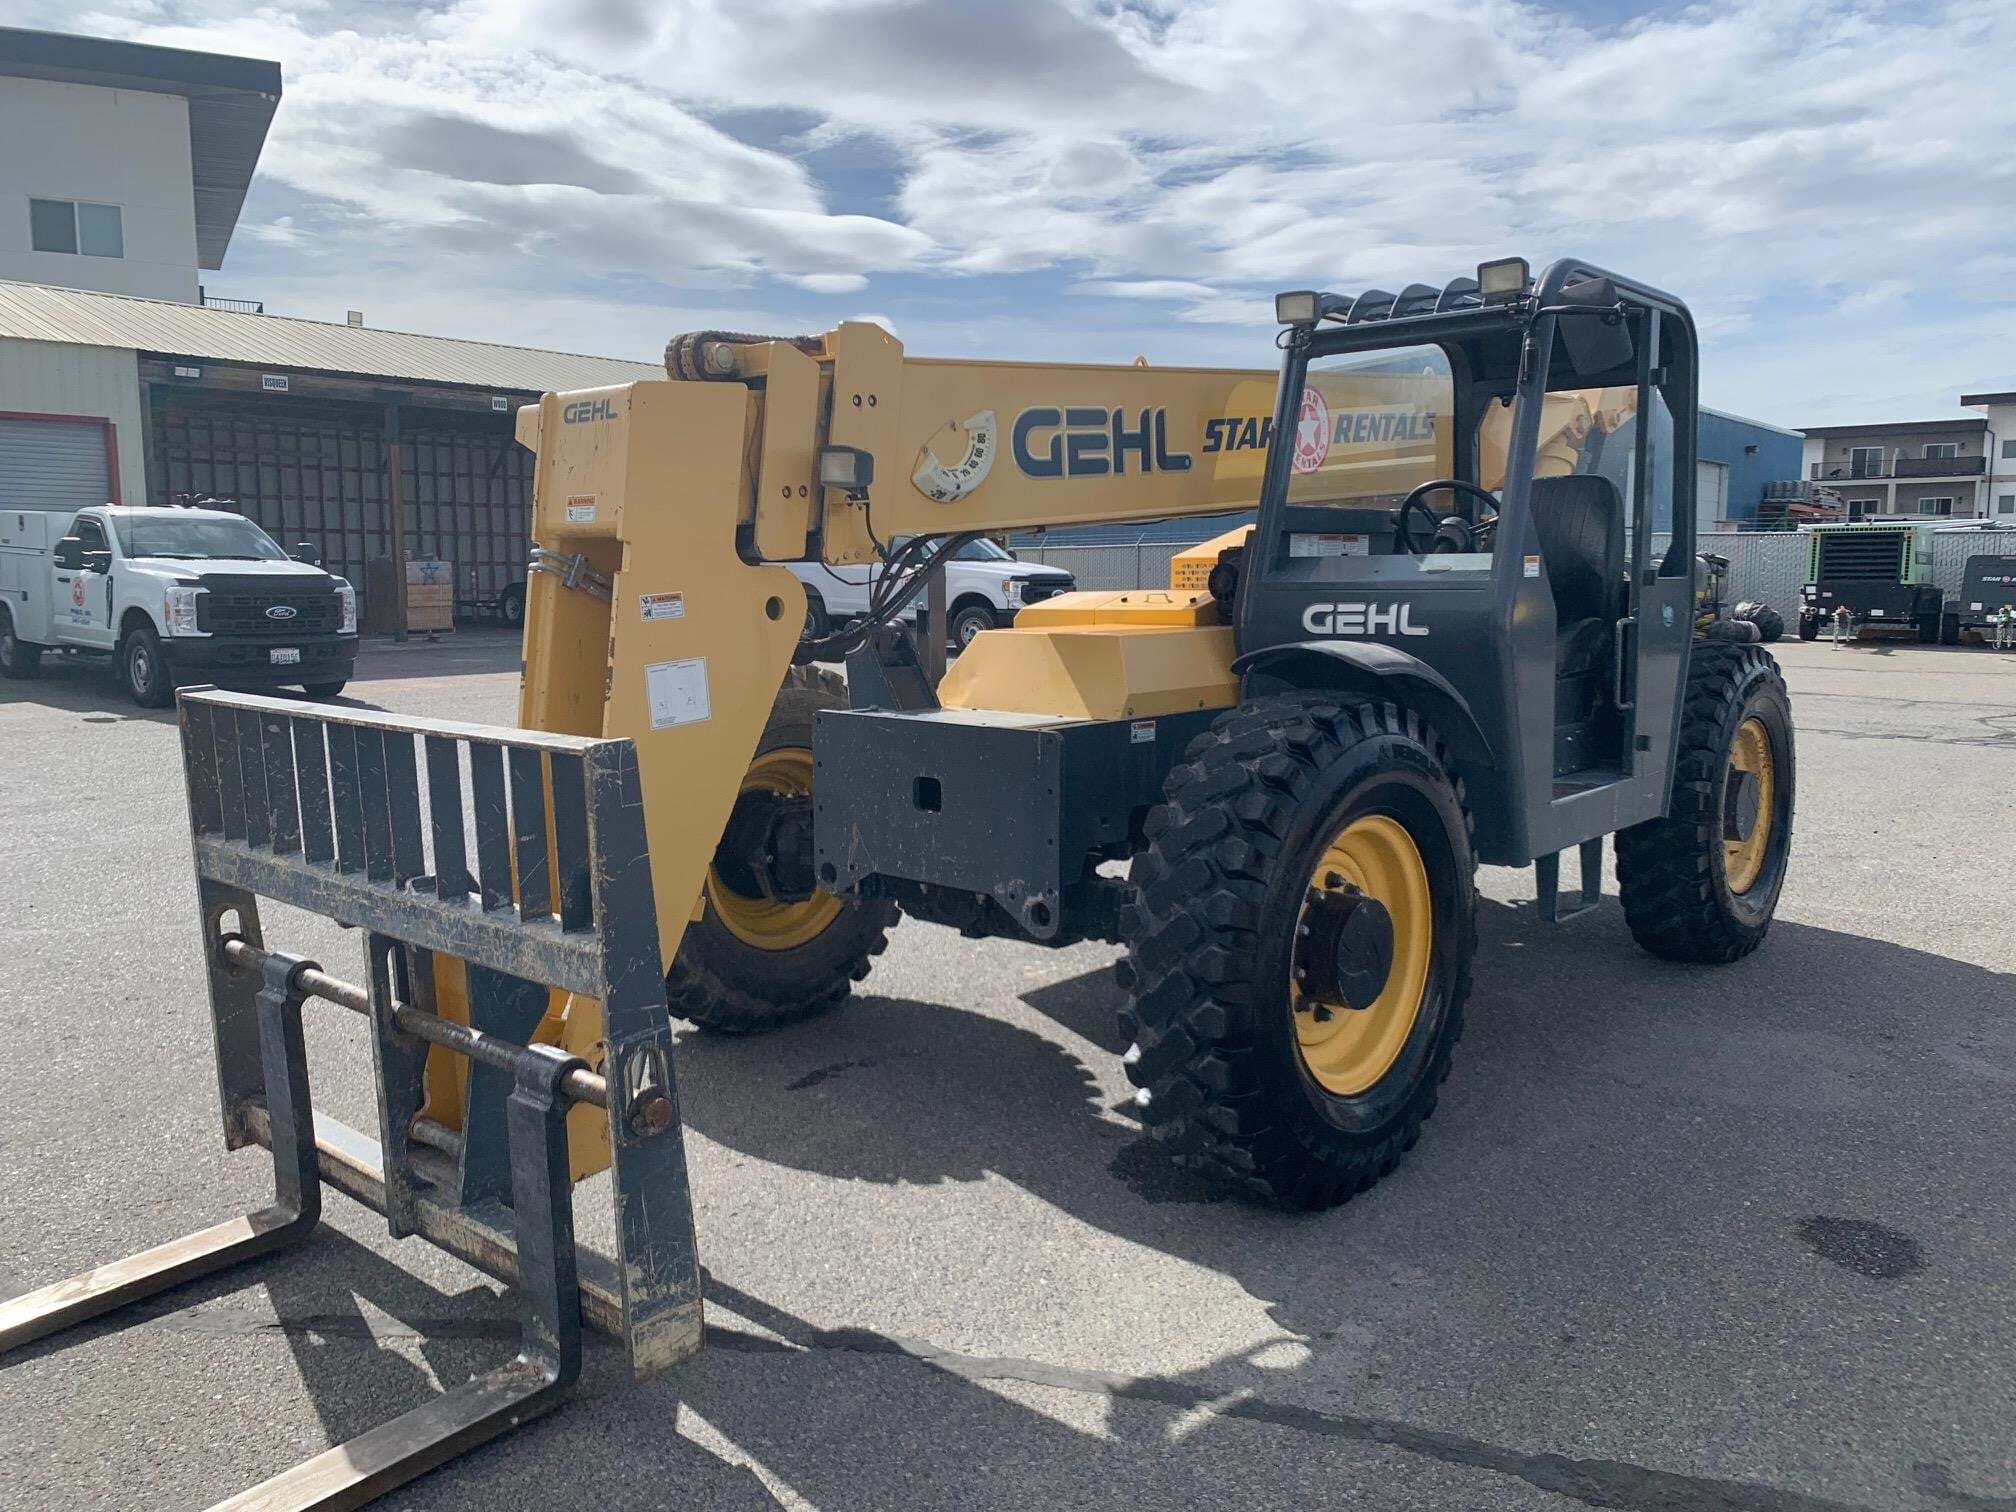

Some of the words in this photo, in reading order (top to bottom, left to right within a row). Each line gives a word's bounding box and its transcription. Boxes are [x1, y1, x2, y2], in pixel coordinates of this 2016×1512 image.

[493, 400, 506, 409] WOOD
[564, 399, 618, 424] GEHL
[977, 433, 986, 444] 80
[1333, 411, 1435, 444] RENTALS
[1012, 406, 1191, 479] GEHL
[1294, 443, 1327, 469] ENTALS
[1302, 603, 1430, 636] GEHL
